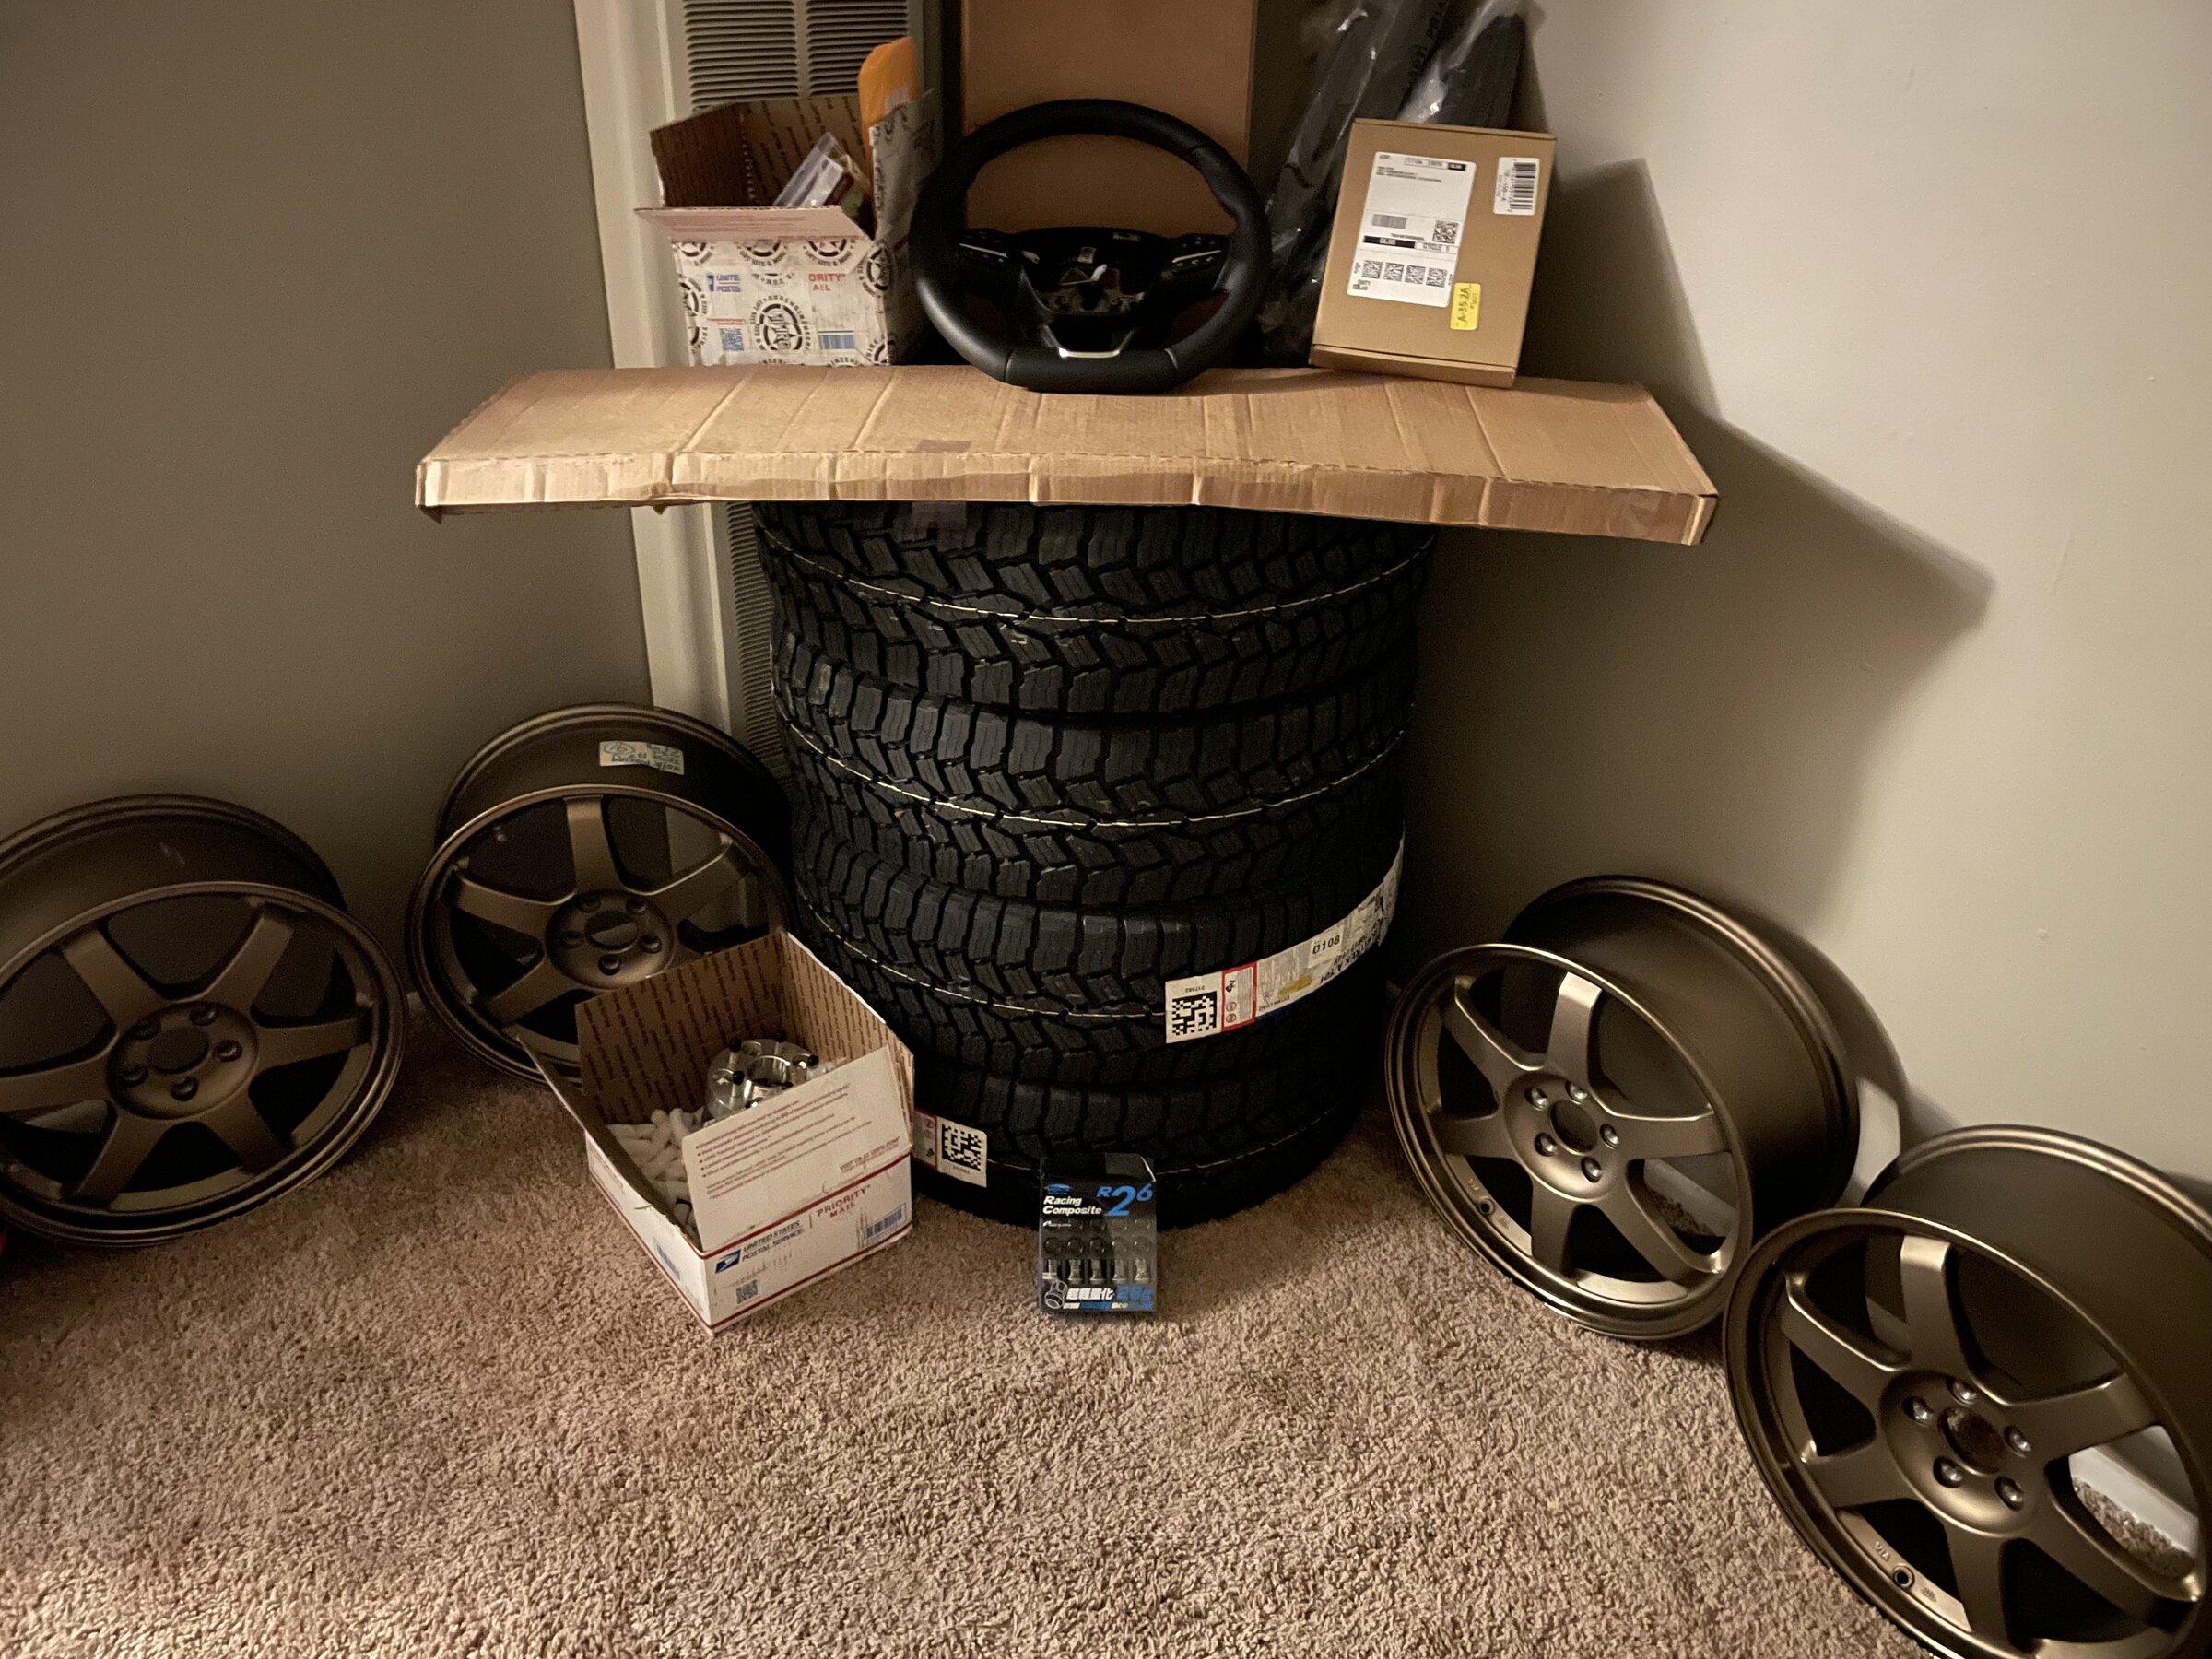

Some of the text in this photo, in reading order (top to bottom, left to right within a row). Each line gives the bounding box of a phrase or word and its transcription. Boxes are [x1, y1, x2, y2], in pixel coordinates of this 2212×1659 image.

[1043, 1195, 1083, 1206] Racing
[1096, 1182, 1153, 1217] R26
[830, 1203, 855, 1218] MAIL
[1042, 1206, 1102, 1217] Composite
[743, 1219, 801, 1253] UNITED STATES
[742, 1245, 771, 1262] POSTAL
